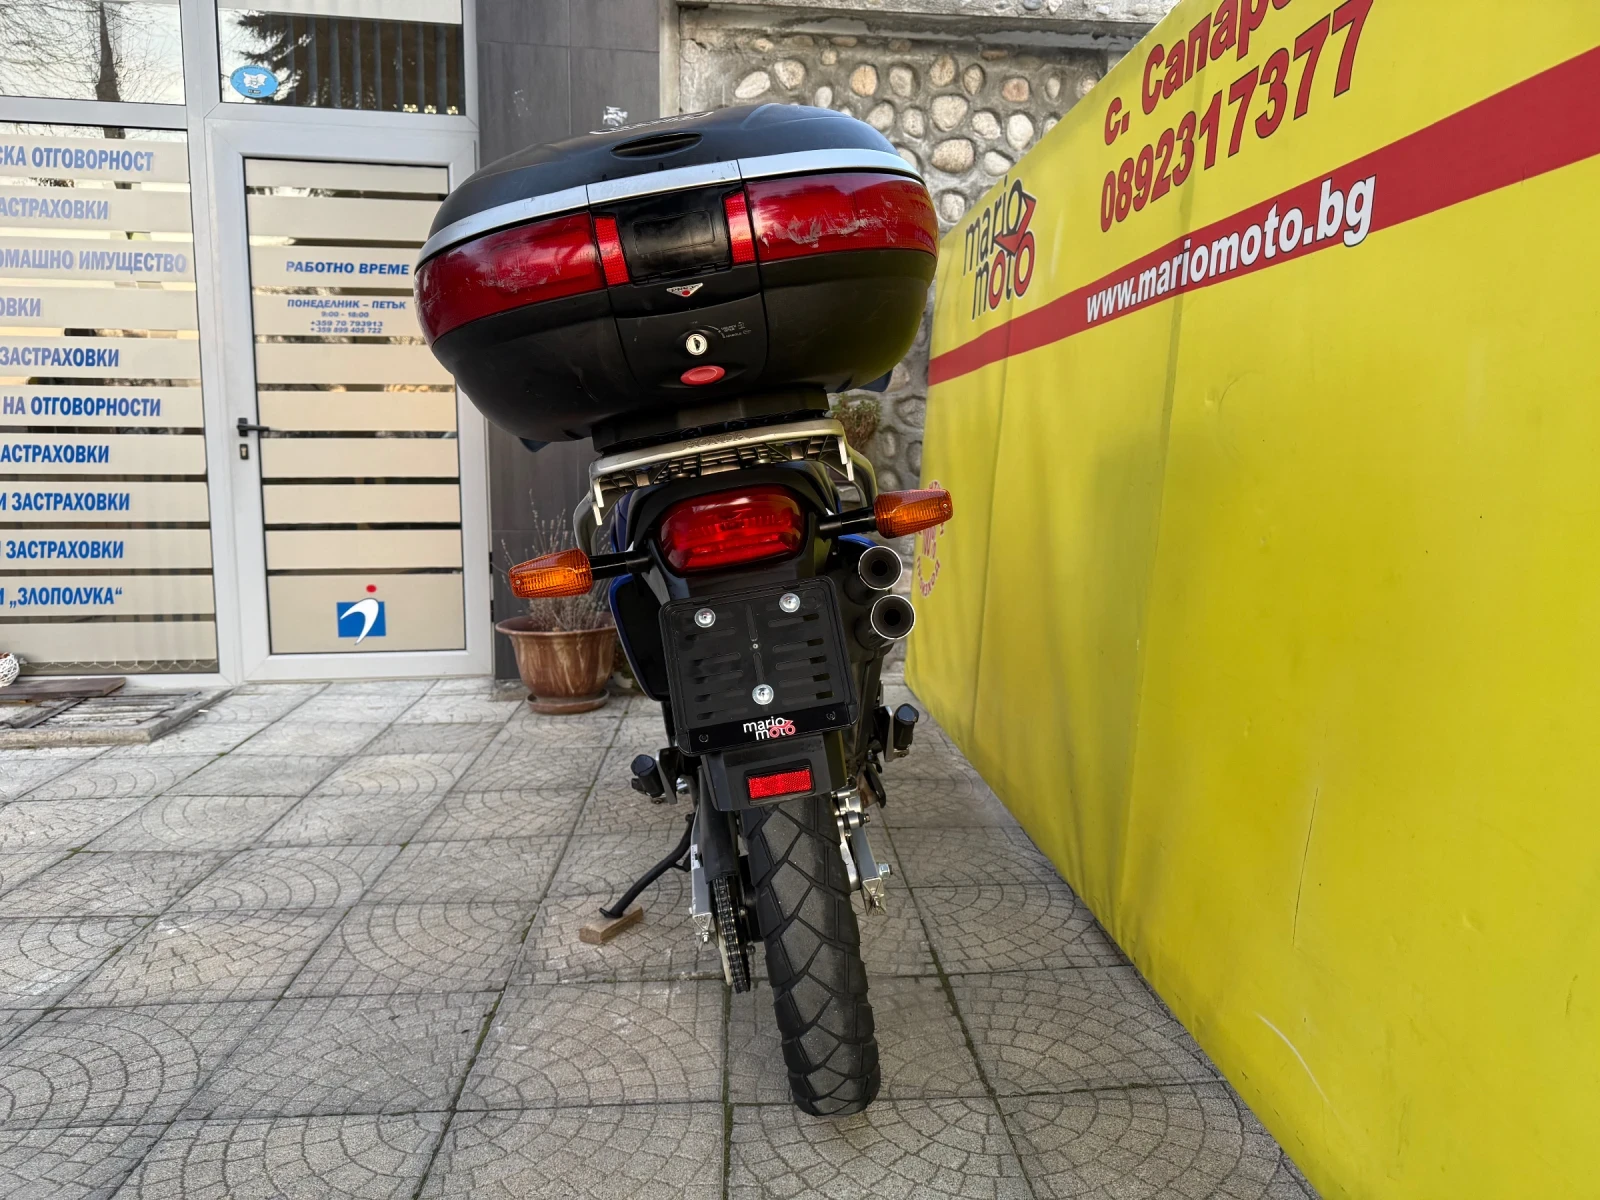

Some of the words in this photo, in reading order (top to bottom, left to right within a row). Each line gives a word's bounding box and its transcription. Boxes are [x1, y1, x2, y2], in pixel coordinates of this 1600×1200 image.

[1104, 96, 1131, 146] с.
[1141, 0, 1293, 115] Сапар
[1100, 0, 1374, 233] 0892317377
[31, 148, 154, 171] ОТГОВОРНОСТ
[963, 175, 1023, 277] mario
[1086, 174, 1377, 323] www.mariomoto.bg
[79, 251, 187, 274] ИМУЩЕСТВО
[286, 261, 355, 274] РАБОТНО
[359, 263, 410, 275] ВРЕМЕ
[971, 230, 1035, 320] moto
[287, 299, 360, 309] ПОНЕДЕЛНИК
[372, 301, 406, 309] ПЕТЪК
[0, 346, 119, 367] ЗАСТРАХОВКИ
[3, 396, 26, 414] НА
[30, 396, 161, 416] ОТГОВОРНОСТИ
[0, 444, 110, 463] АСТРАХОВКИ
[11, 492, 130, 511] ЗАСТРАХОВКИ
[5, 540, 124, 559] ЗАСТРАХОВКИ
[742, 715, 785, 733] mario
[755, 725, 796, 740] moto
